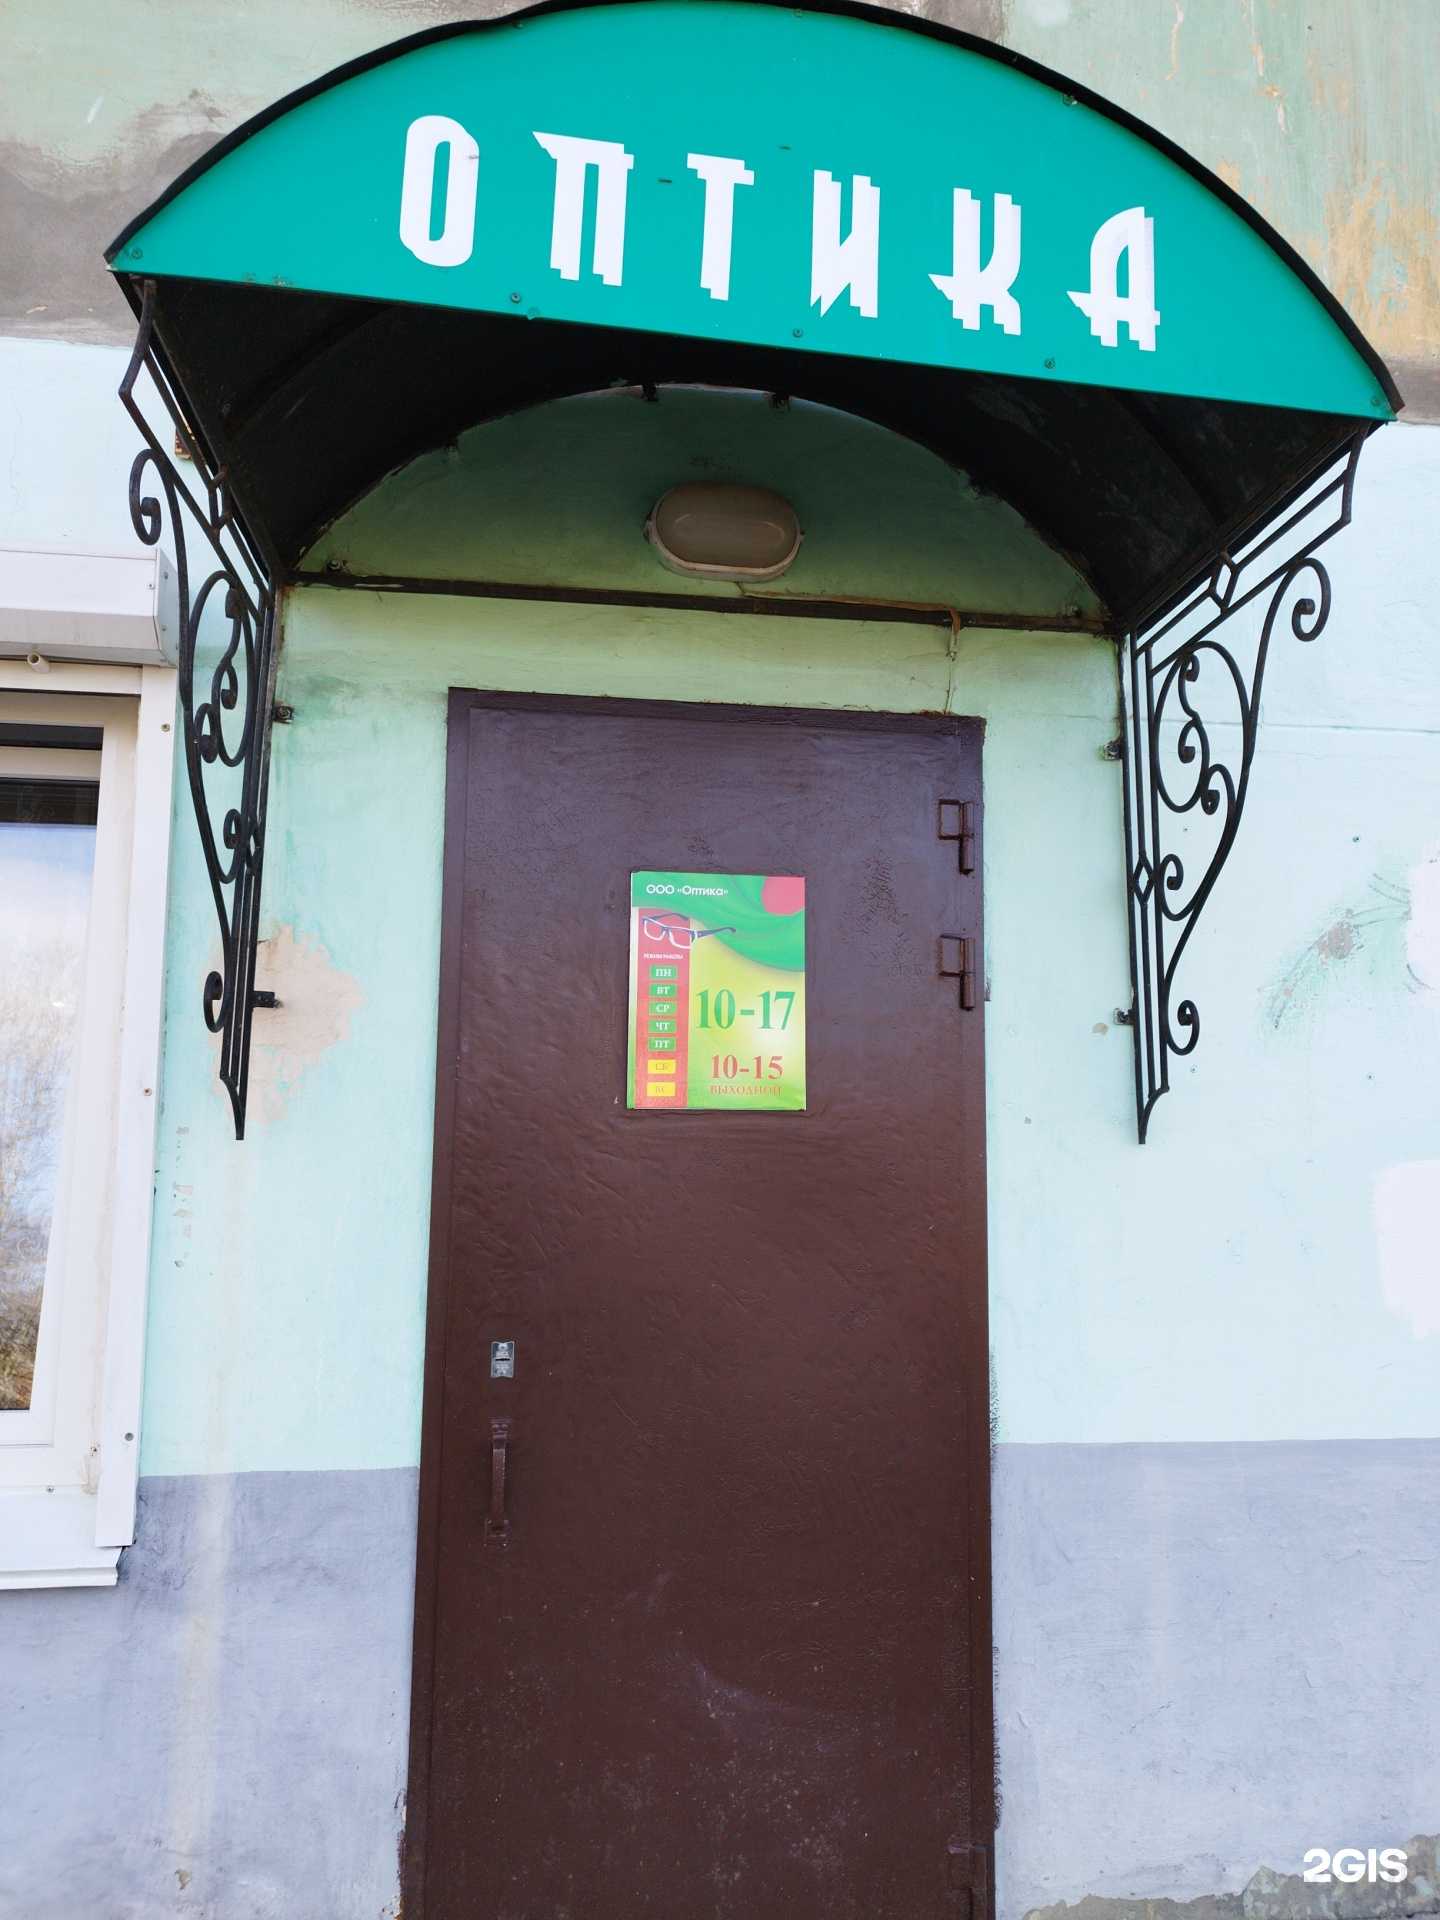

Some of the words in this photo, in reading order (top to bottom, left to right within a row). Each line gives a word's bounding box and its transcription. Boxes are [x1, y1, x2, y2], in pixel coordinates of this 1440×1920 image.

[400, 115, 1160, 352] ОПТИКА
[646, 884, 675, 895] ООО
[655, 968, 672, 977] ПН
[655, 1004, 670, 1013] СР
[696, 988, 796, 1030] 10-17
[655, 1022, 670, 1031] ЧТ
[655, 1040, 670, 1049] ПТ
[711, 1054, 784, 1080] 10-15
